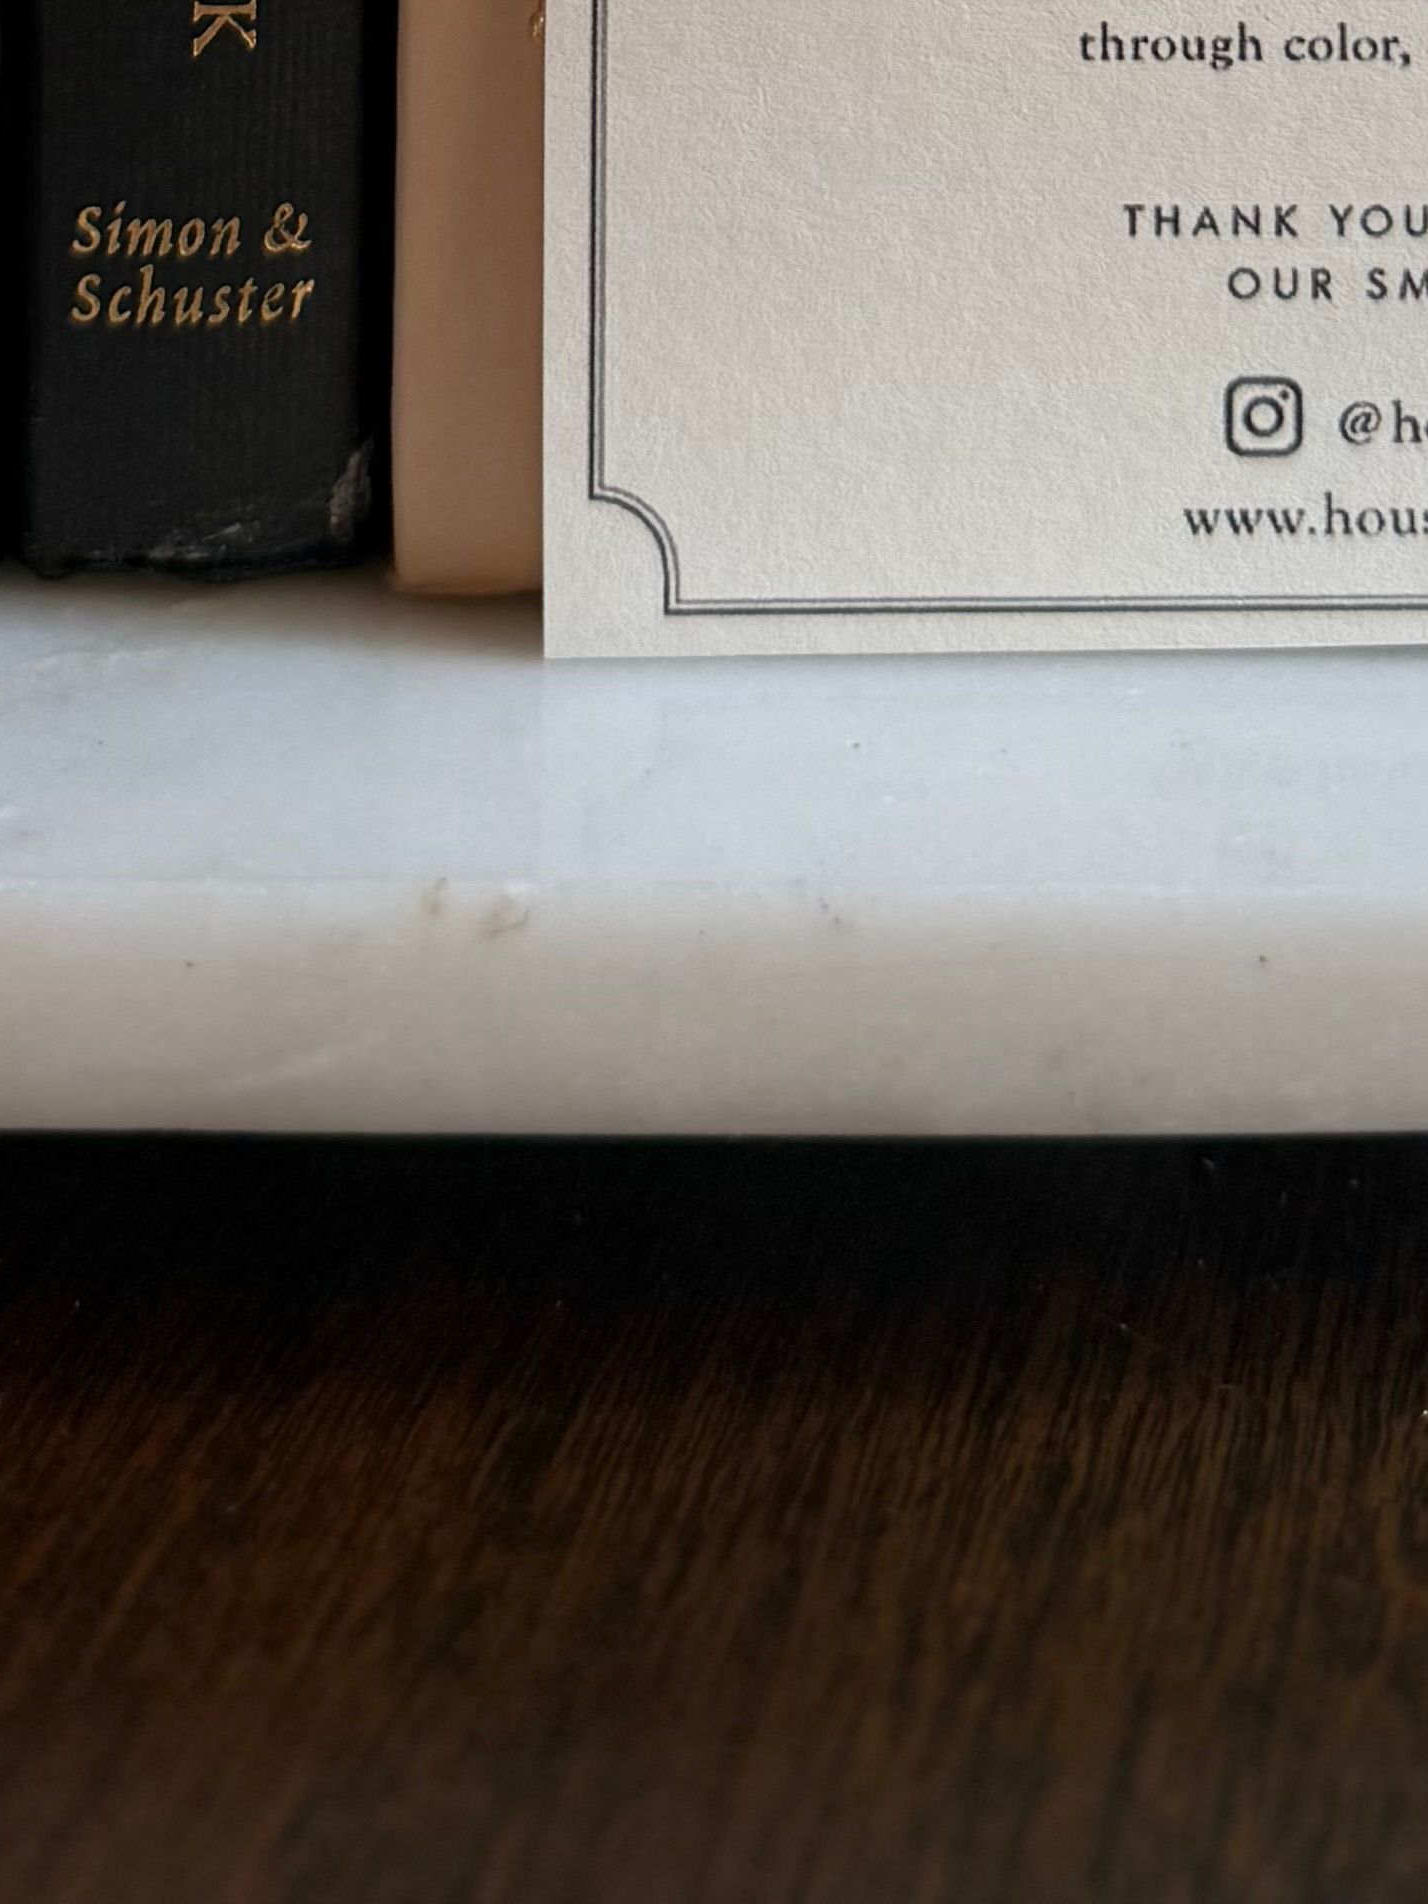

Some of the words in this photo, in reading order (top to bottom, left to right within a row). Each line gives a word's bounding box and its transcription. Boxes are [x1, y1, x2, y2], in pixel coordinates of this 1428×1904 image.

[1080, 21, 1263, 71] through
[1284, 22, 1411, 67] color,
[72, 201, 240, 258] Simon
[264, 203, 311, 254] &
[1124, 204, 1298, 238] THANK
[71, 266, 315, 326] Schuster
[1227, 267, 1332, 301] OUR
